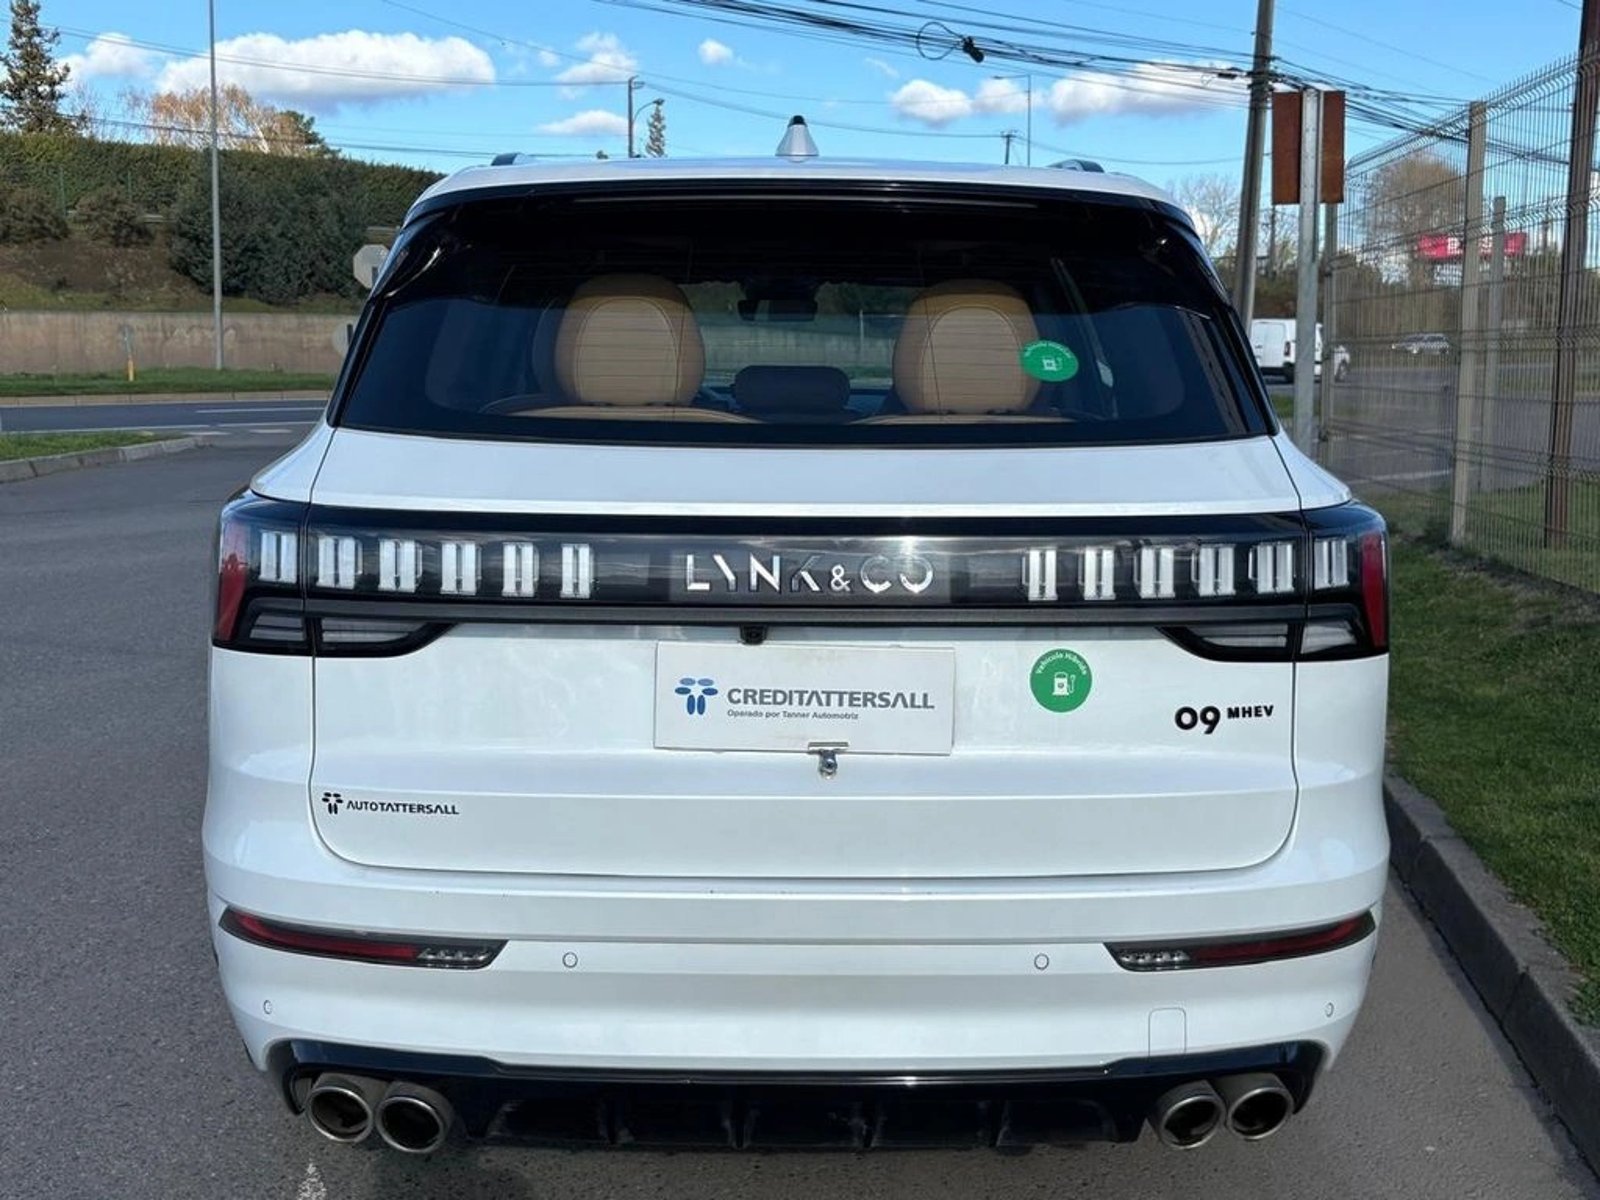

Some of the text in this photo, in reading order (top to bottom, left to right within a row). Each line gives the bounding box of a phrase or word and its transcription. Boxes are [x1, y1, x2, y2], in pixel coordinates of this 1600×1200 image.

[727, 687, 935, 709] CREDITATTERSALL
[727, 709, 763, 718] Operado
[782, 711, 810, 719] Tanner
[812, 712, 859, 720] Automotriz
[1175, 705, 1274, 735] 09 MHEV
[346, 800, 460, 815] AUTOTATTERSALL
